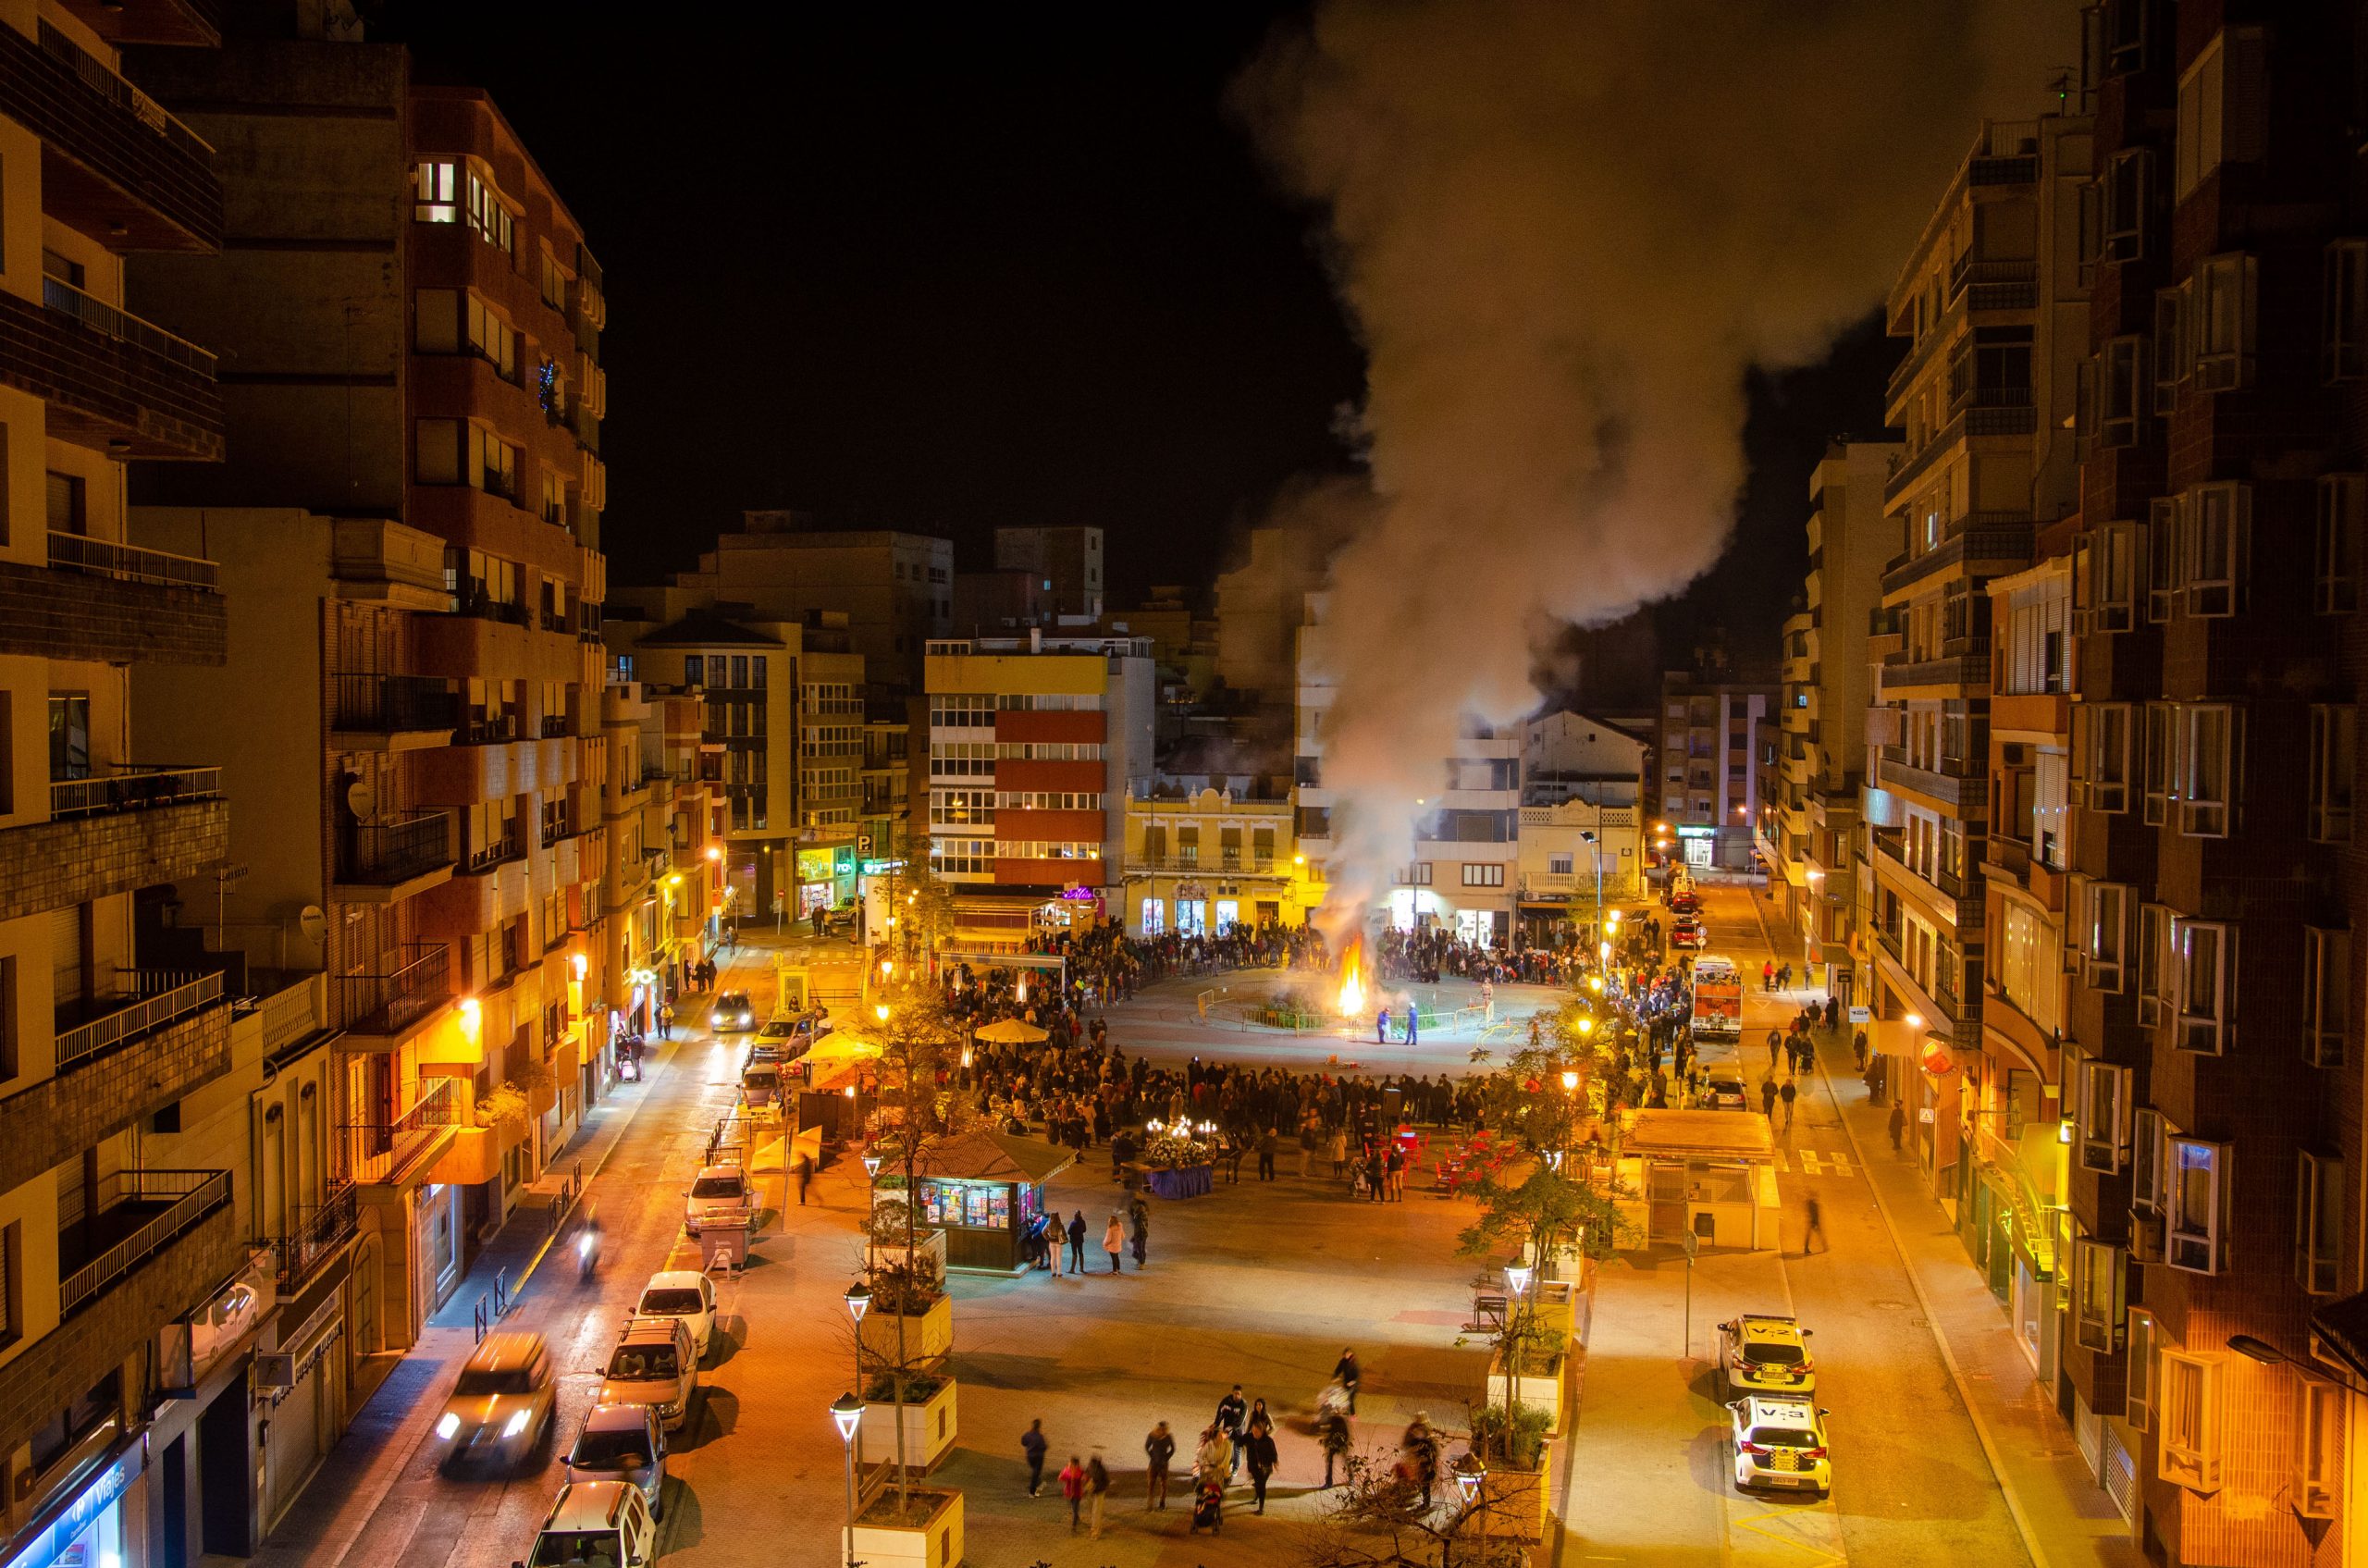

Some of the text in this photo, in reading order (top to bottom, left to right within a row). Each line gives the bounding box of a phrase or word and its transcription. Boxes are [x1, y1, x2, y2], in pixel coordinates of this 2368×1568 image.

[858, 835, 870, 849] P
[1752, 1327, 1790, 1337] V-2
[1760, 1408, 1805, 1418] V-3
[95, 1465, 125, 1505] Viajes
